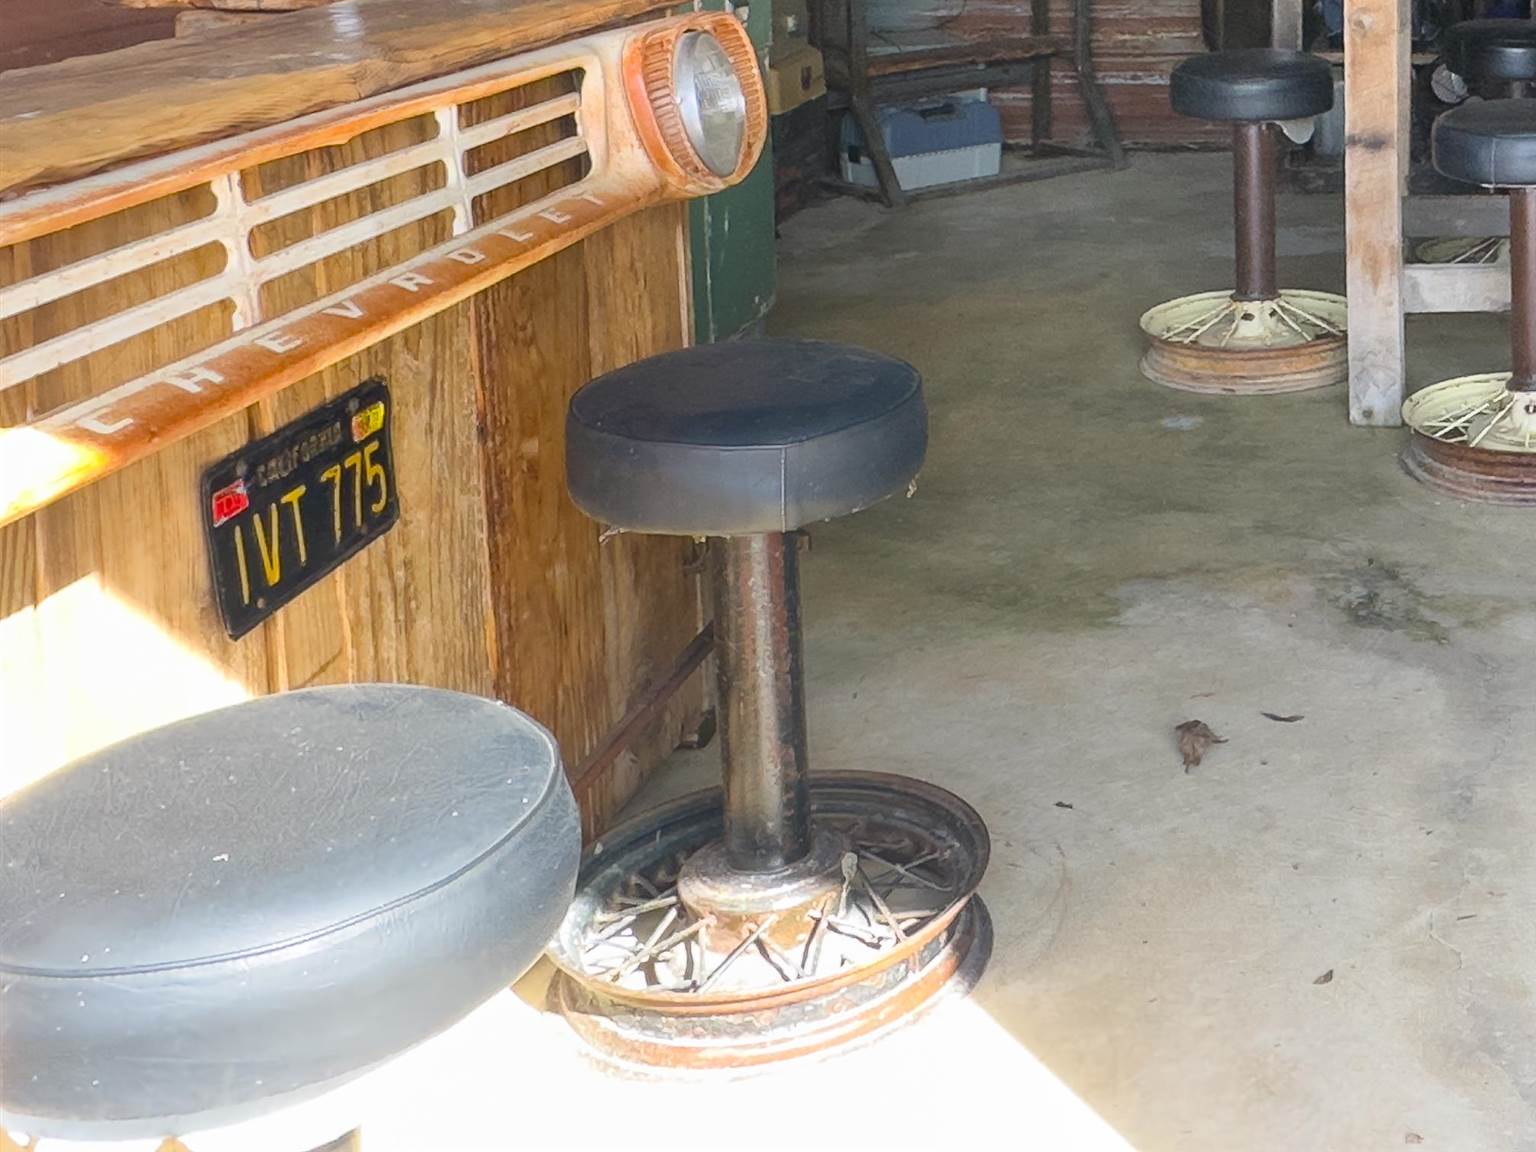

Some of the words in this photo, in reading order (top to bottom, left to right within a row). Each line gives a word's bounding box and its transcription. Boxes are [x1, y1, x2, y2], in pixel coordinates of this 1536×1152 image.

[81, 196, 604, 435] CHEVROLET
[235, 484, 307, 605] IVT
[320, 440, 387, 546] 775
